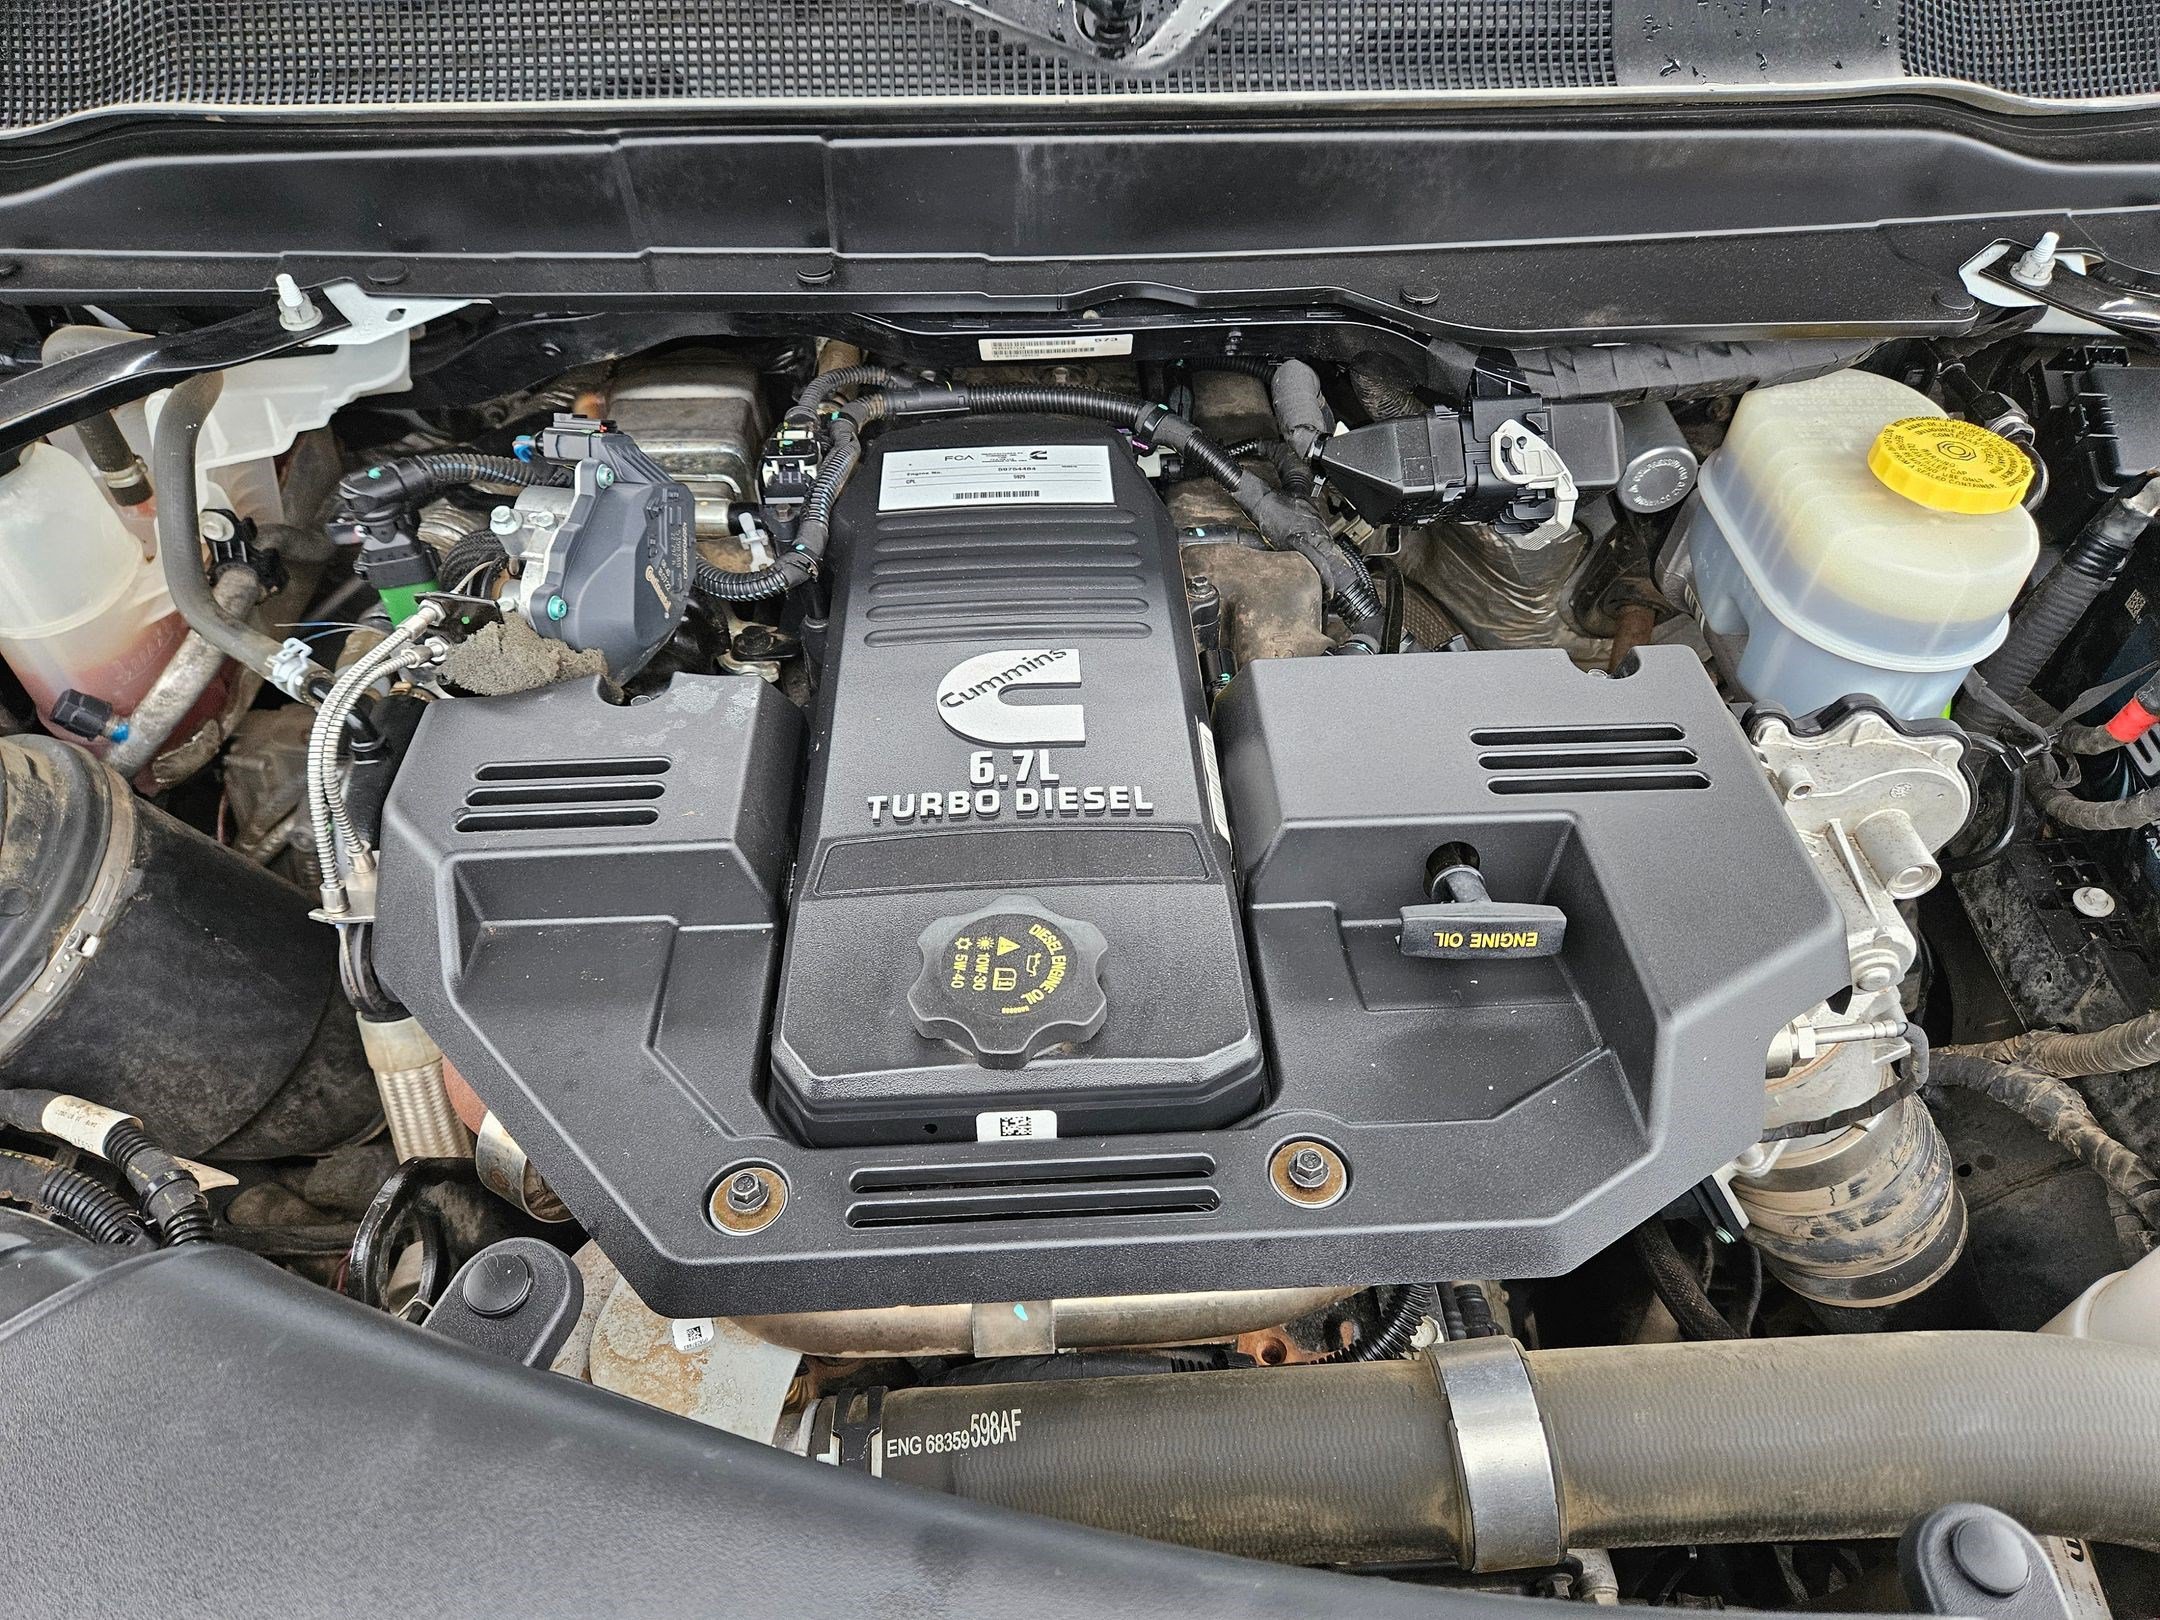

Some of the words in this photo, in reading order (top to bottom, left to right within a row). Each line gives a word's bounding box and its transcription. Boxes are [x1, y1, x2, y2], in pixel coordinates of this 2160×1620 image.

[940, 648, 1067, 708] Cummins
[970, 750, 1060, 788] 6.7L
[867, 789, 1001, 824] TURBO
[1015, 785, 1154, 818] DIESEL
[1028, 923, 1063, 956] DIESEL
[1433, 932, 1464, 948] OIL
[1469, 932, 1539, 948] ENGINE
[950, 953, 969, 989] 5W-40
[972, 952, 990, 991] 10W-30
[1039, 955, 1067, 994] ENGINE
[1020, 988, 1045, 1005] OIL
[886, 1435, 922, 1458] ENG
